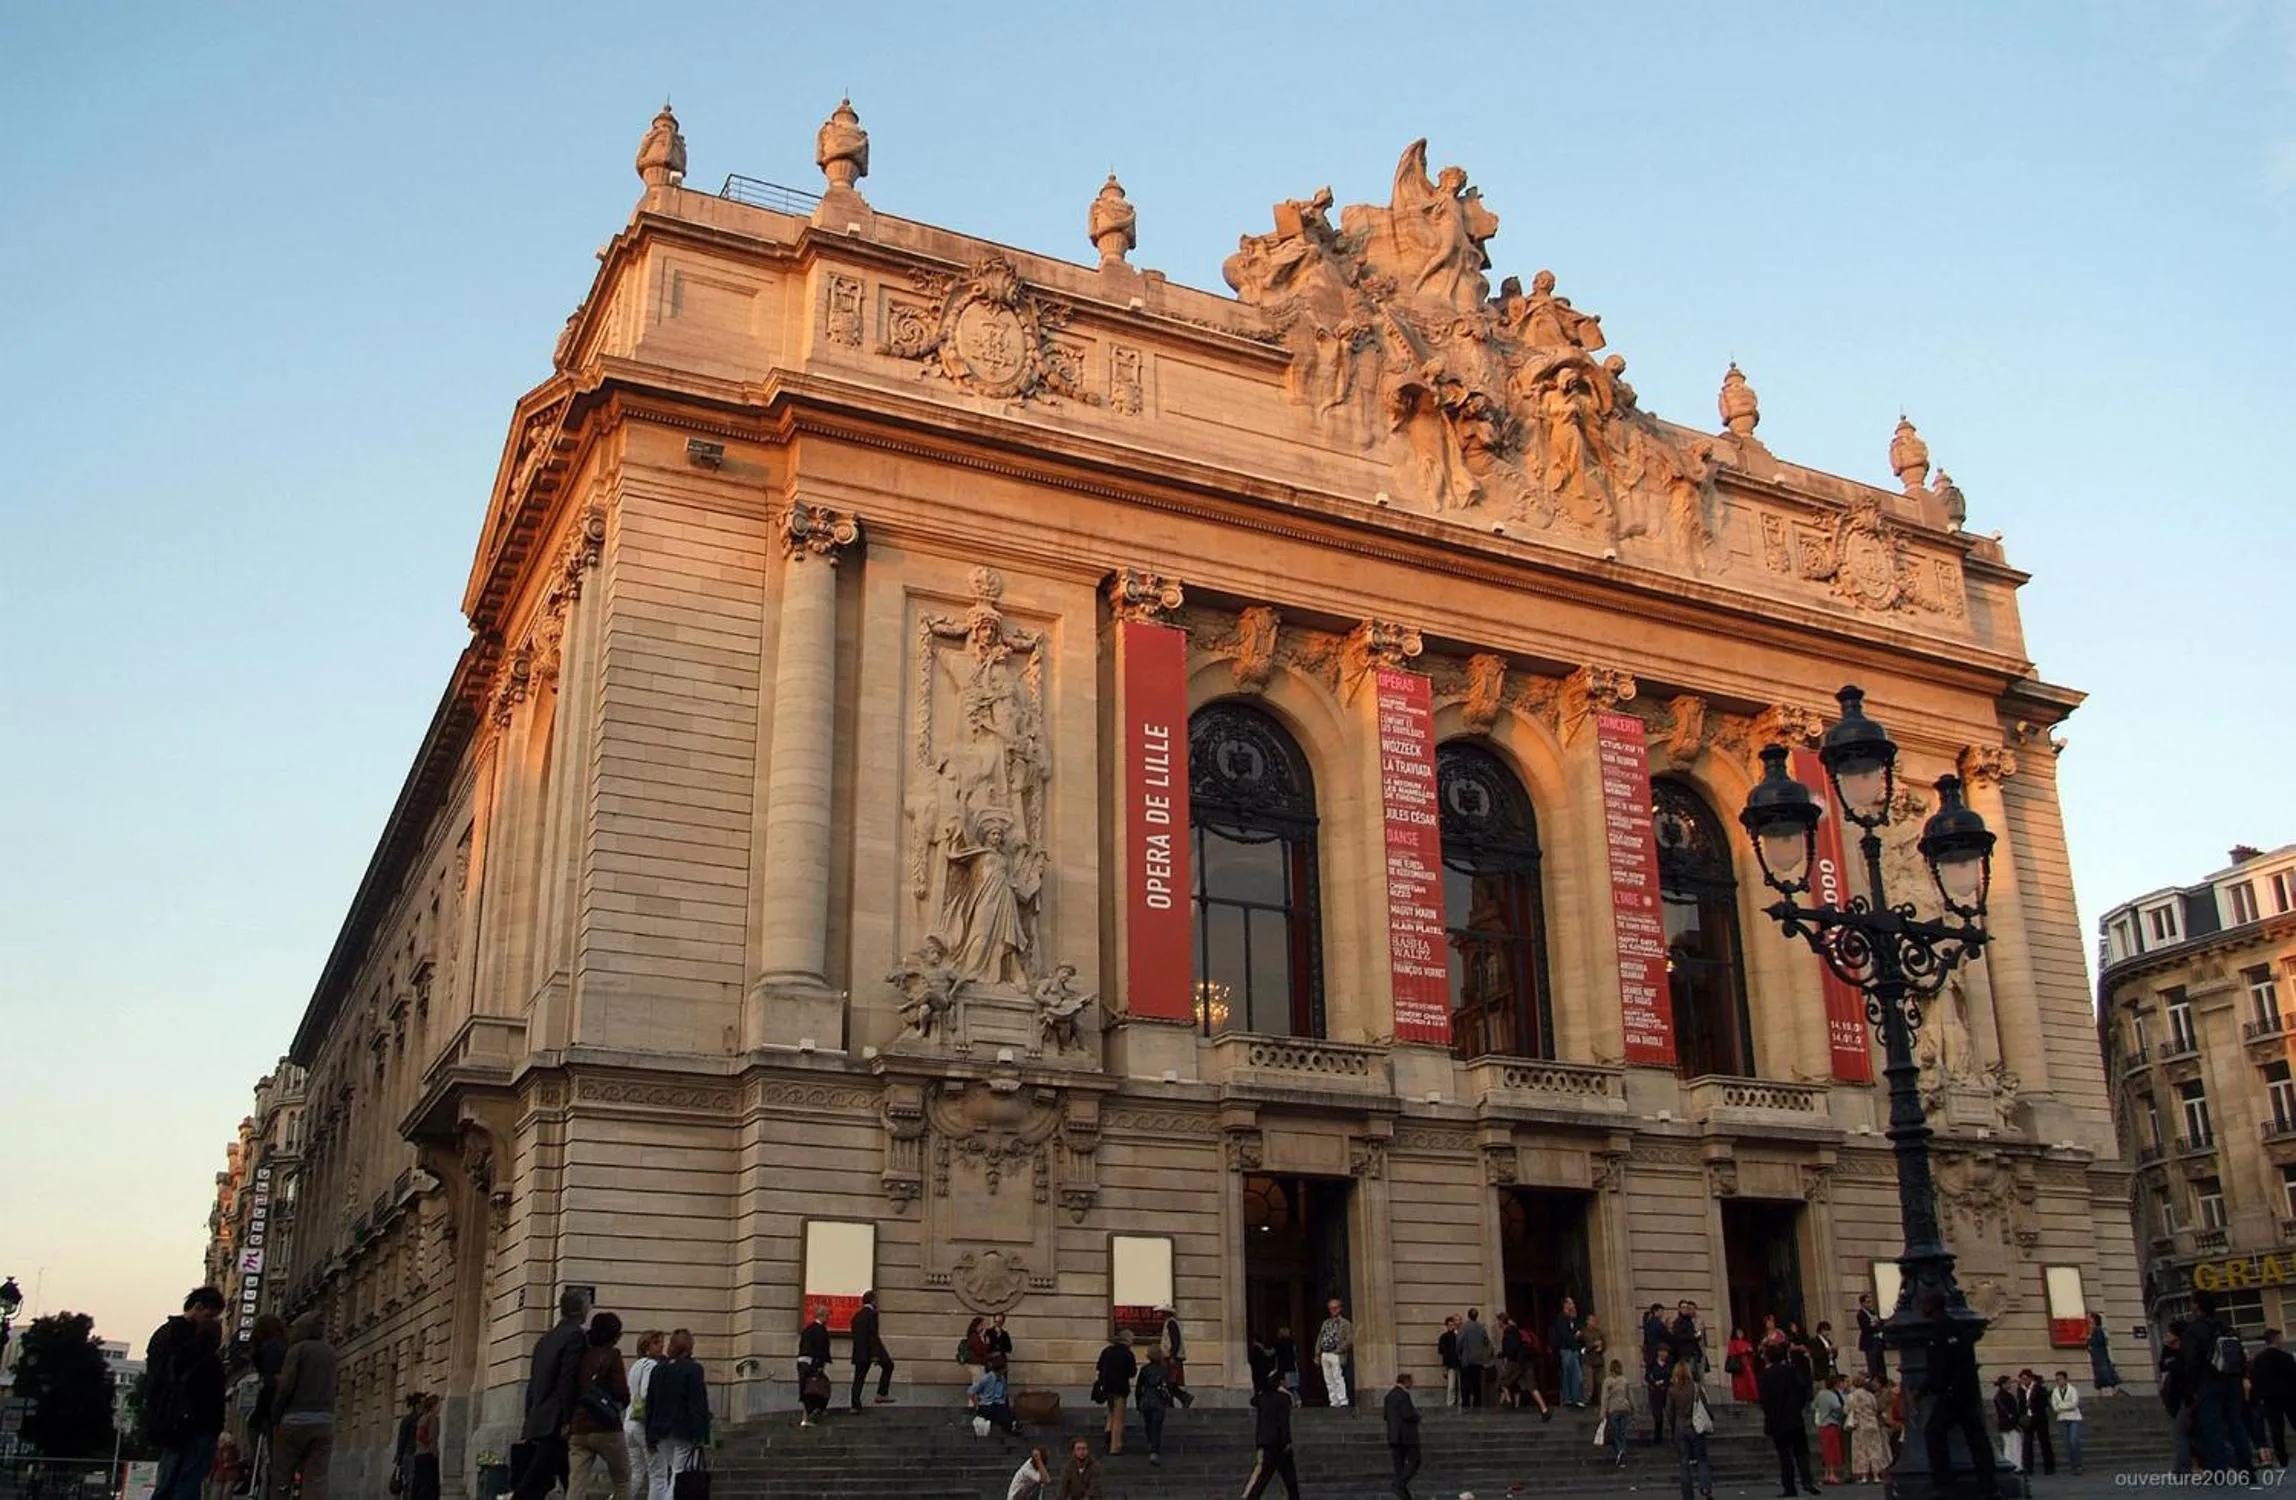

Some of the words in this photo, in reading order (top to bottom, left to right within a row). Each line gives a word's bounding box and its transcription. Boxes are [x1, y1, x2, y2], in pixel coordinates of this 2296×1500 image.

[1144, 723, 1169, 787] LILLE
[1382, 739, 1422, 757] WOZZECK
[1383, 759, 1394, 772] LA
[1395, 760, 1432, 777] TRAVIATA
[1145, 794, 1170, 824] DE
[1386, 807, 1410, 822] JULES
[1411, 809, 1437, 826] CÉSAR
[1387, 828, 1420, 847] DANSE
[1146, 834, 1172, 909] OPERA
[1391, 920, 1414, 931] ALAIN
[2193, 1252, 2296, 1292] GRA
[239, 1275, 258, 1341] HOTEL
